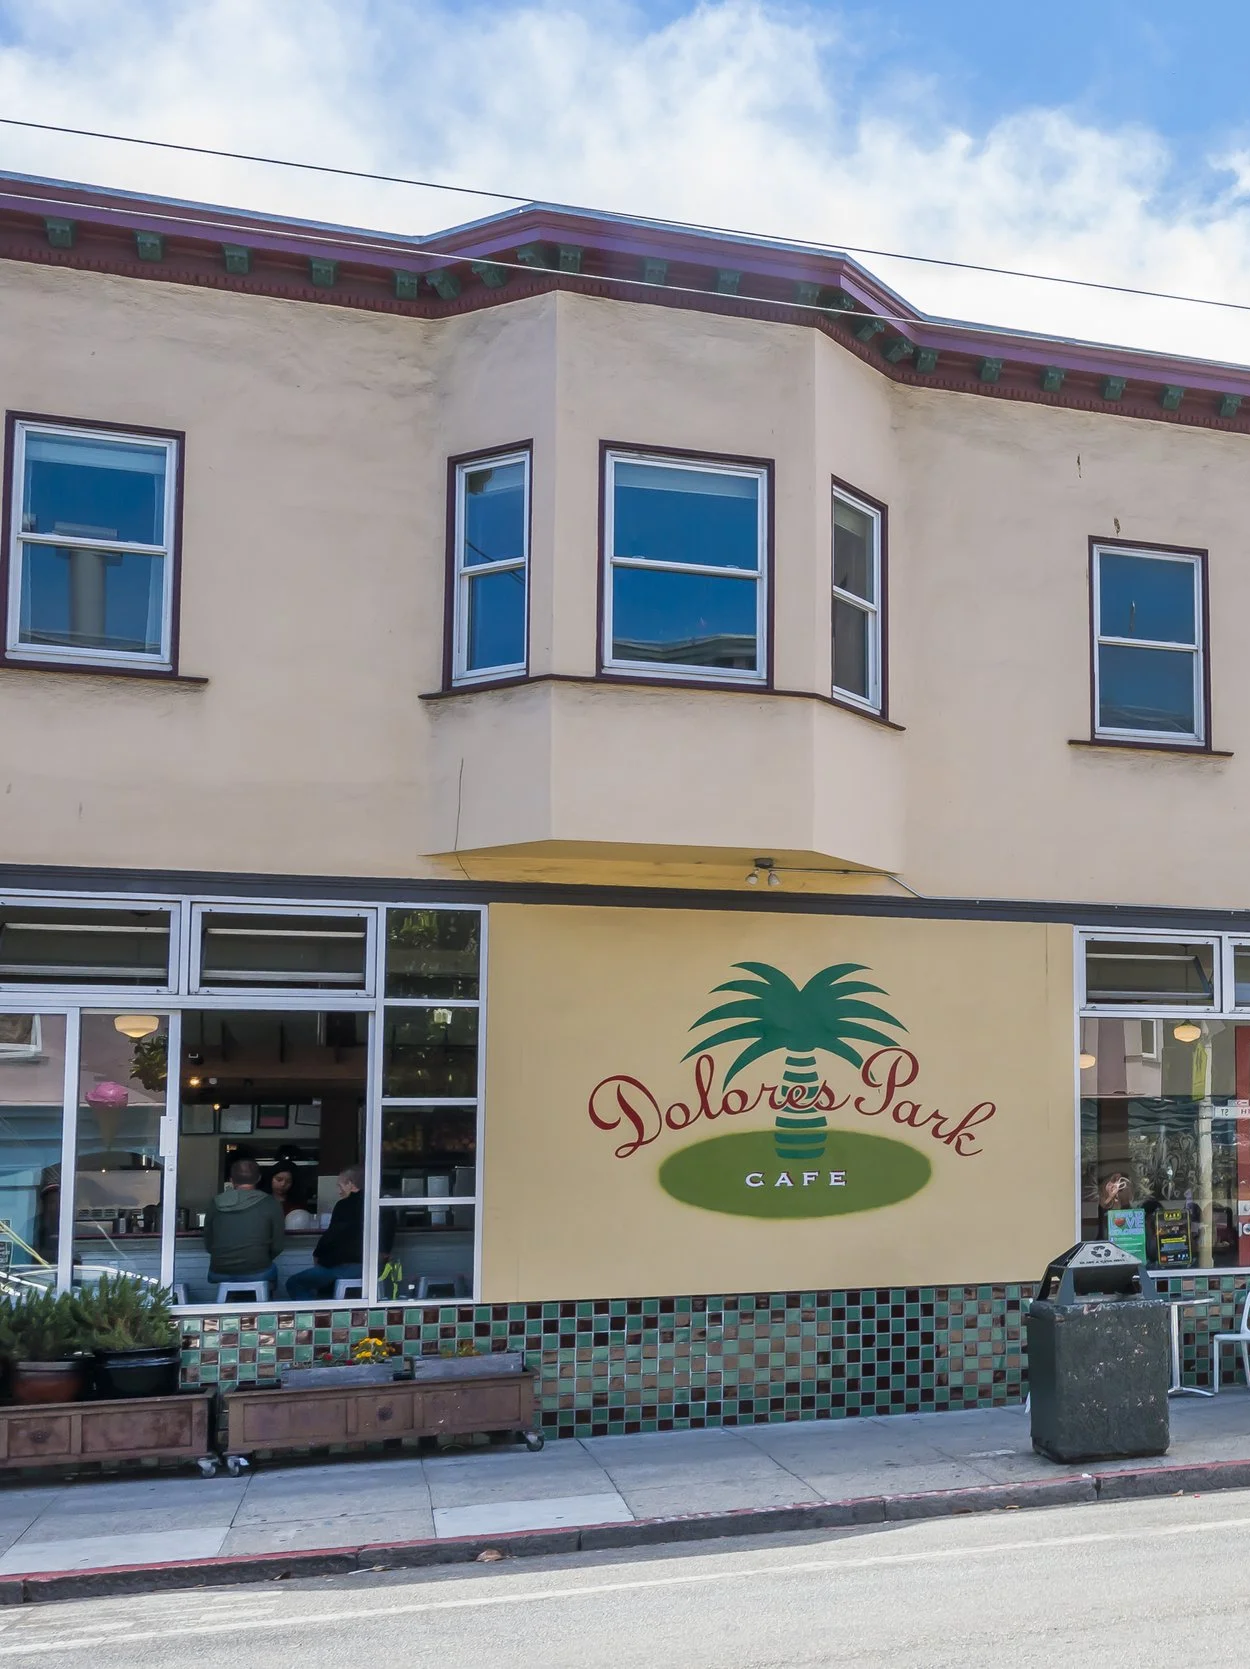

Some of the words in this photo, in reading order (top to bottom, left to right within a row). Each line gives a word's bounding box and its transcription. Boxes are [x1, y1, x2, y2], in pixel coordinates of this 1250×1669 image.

[588, 1053, 851, 1159] Dolores
[854, 1047, 997, 1157] Park
[745, 1170, 847, 1187] CAFE
